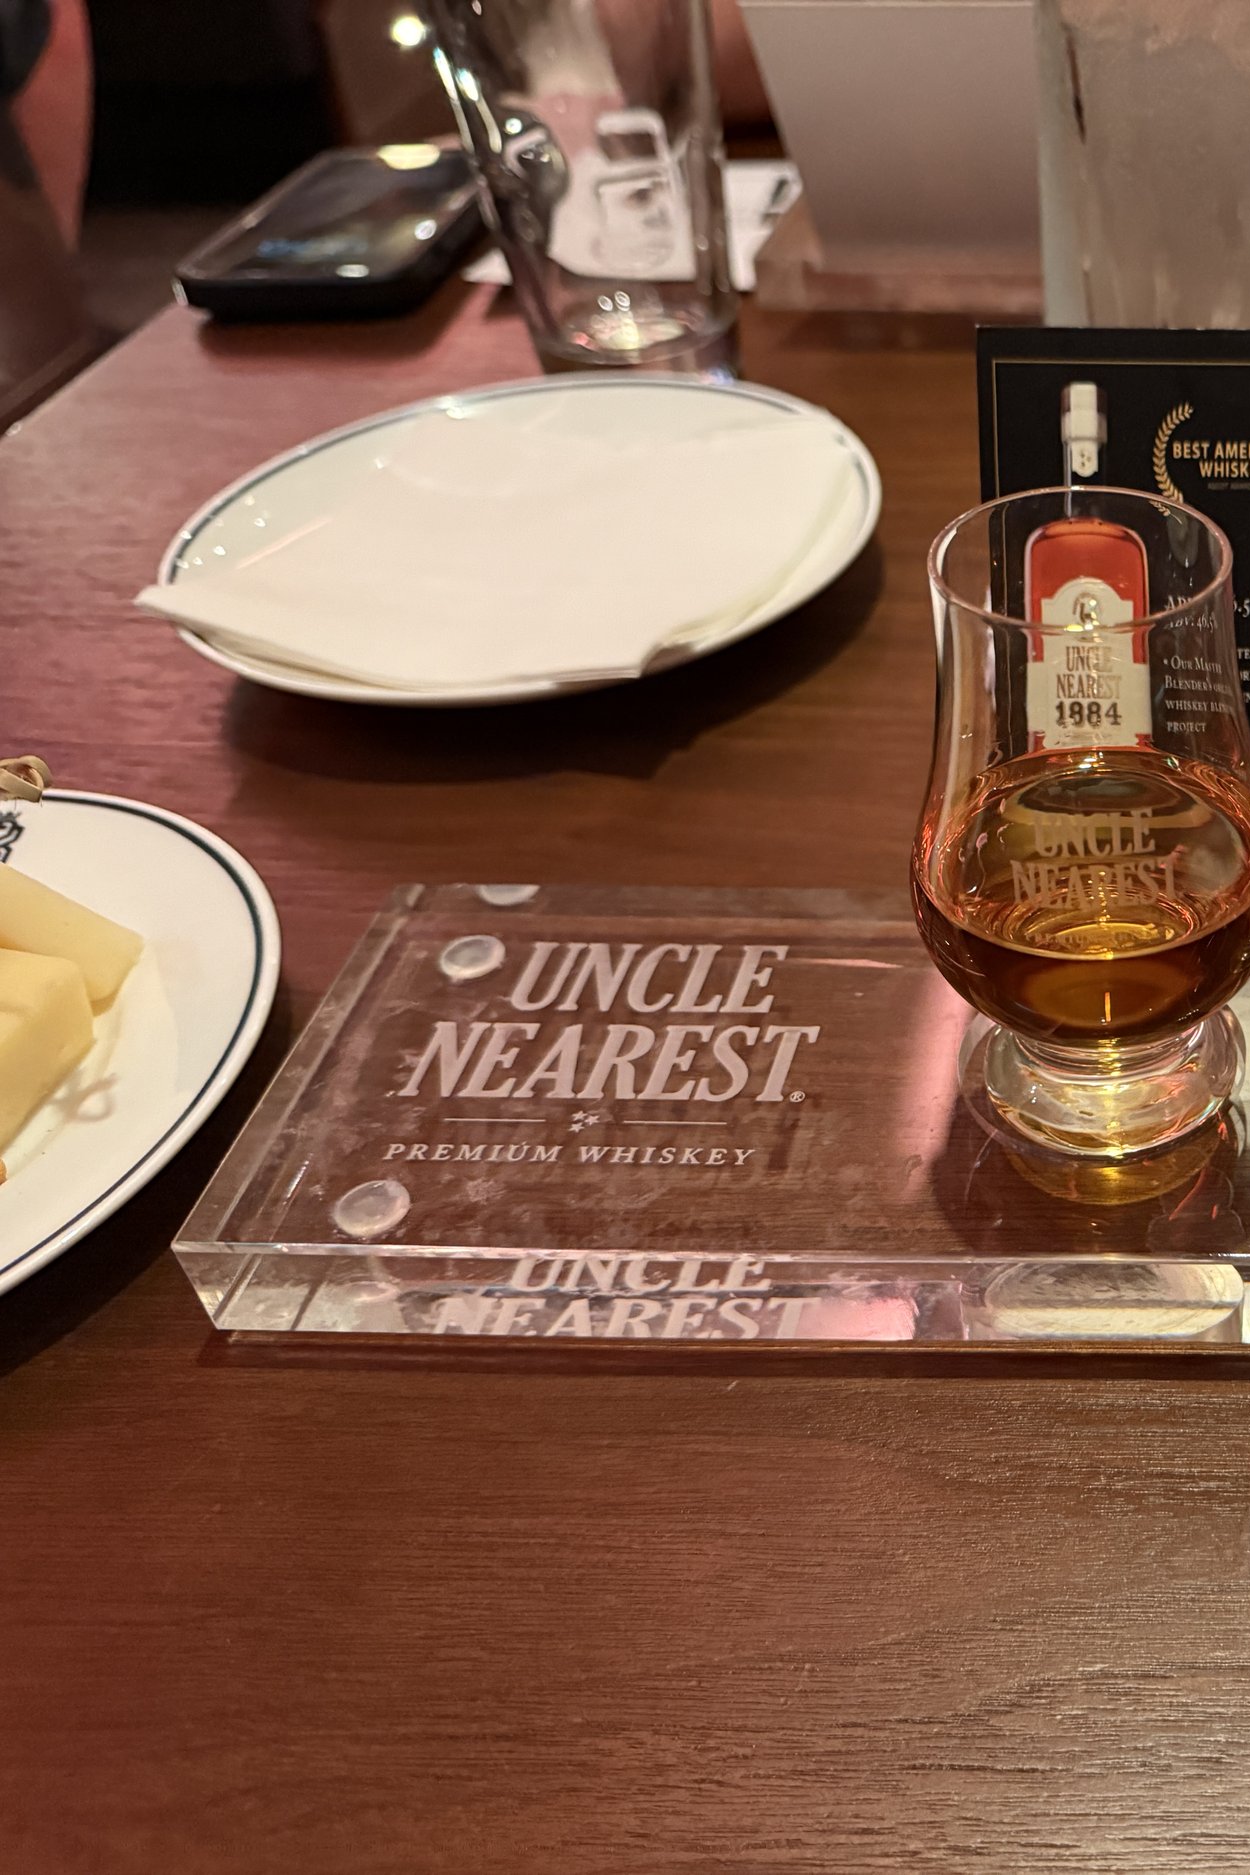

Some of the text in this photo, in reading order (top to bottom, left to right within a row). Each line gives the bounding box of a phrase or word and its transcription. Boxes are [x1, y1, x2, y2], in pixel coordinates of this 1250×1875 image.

[1172, 440, 1210, 460] BEST
[1065, 645, 1114, 673] UNCLE
[1055, 673, 1123, 700] NEAREST
[1055, 701, 1123, 729] 1884
[1164, 699, 1208, 712] WHISKEY
[1166, 722, 1207, 734] PROJECT
[1033, 807, 1157, 858] UNCLE
[1009, 856, 1180, 911] NEAREST
[508, 941, 790, 1014] UNCLE
[382, 1140, 756, 1167] PREMIUM WHISKEY
